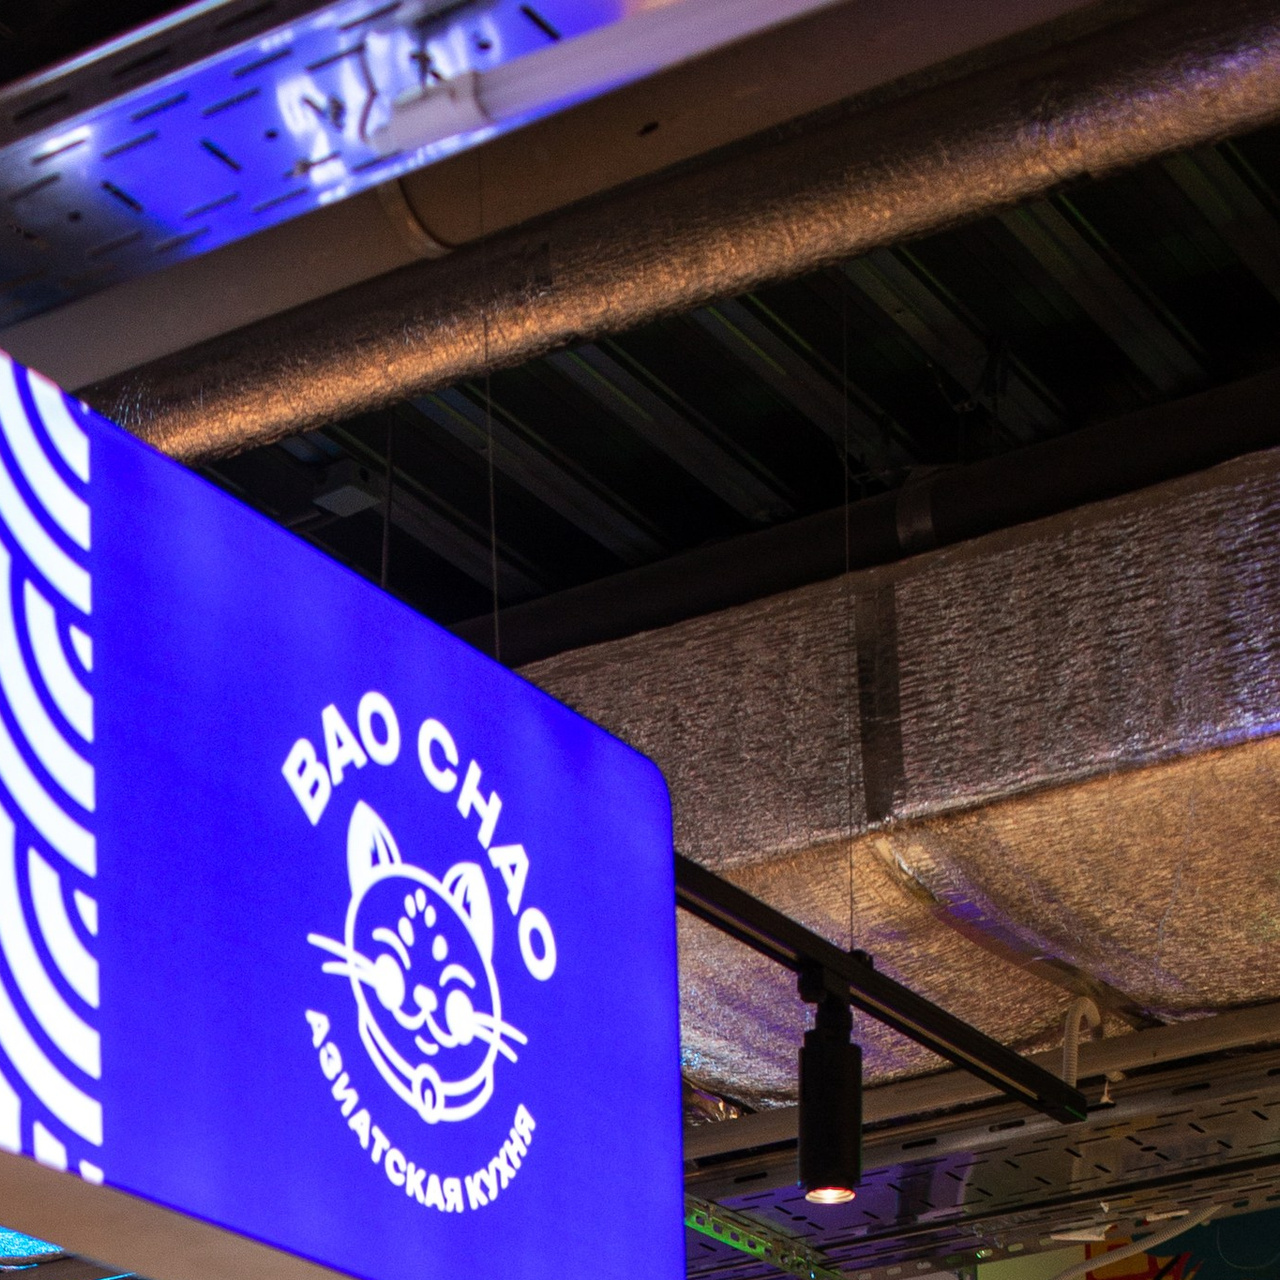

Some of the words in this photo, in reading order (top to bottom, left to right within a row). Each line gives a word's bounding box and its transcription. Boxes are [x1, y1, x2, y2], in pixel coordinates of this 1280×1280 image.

[281, 691, 401, 826] BAO
[417, 718, 557, 981] CHAO
[305, 1009, 464, 1213] АЗИАТСКАЯ
[464, 1103, 536, 1209] КУХНЯ
